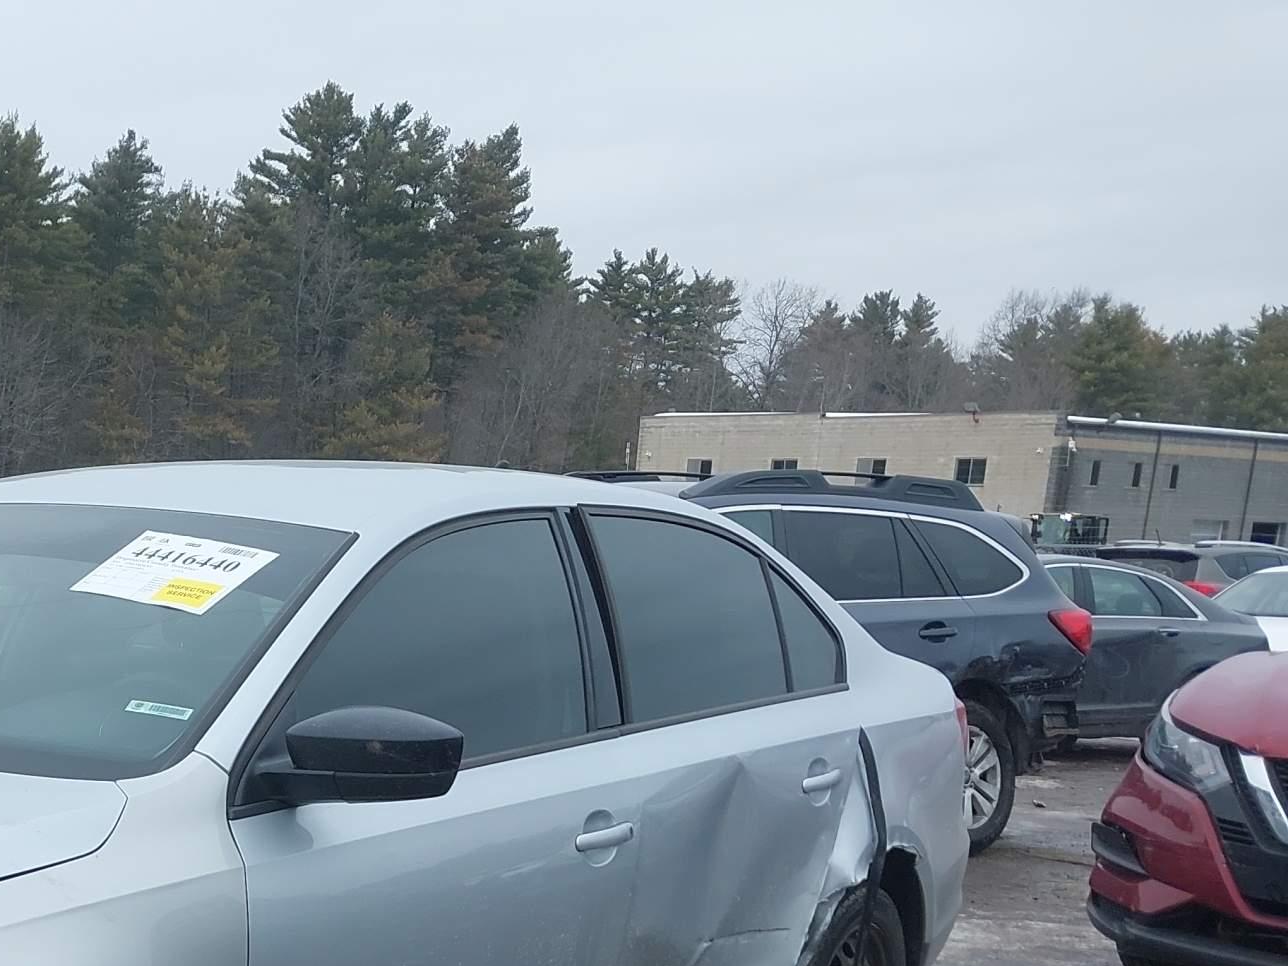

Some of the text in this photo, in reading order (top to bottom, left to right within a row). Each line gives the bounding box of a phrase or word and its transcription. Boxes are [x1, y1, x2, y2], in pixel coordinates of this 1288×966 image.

[132, 547, 241, 573] 44416440
[166, 590, 202, 600] SERVICE
[168, 583, 217, 596] INSPECTION
